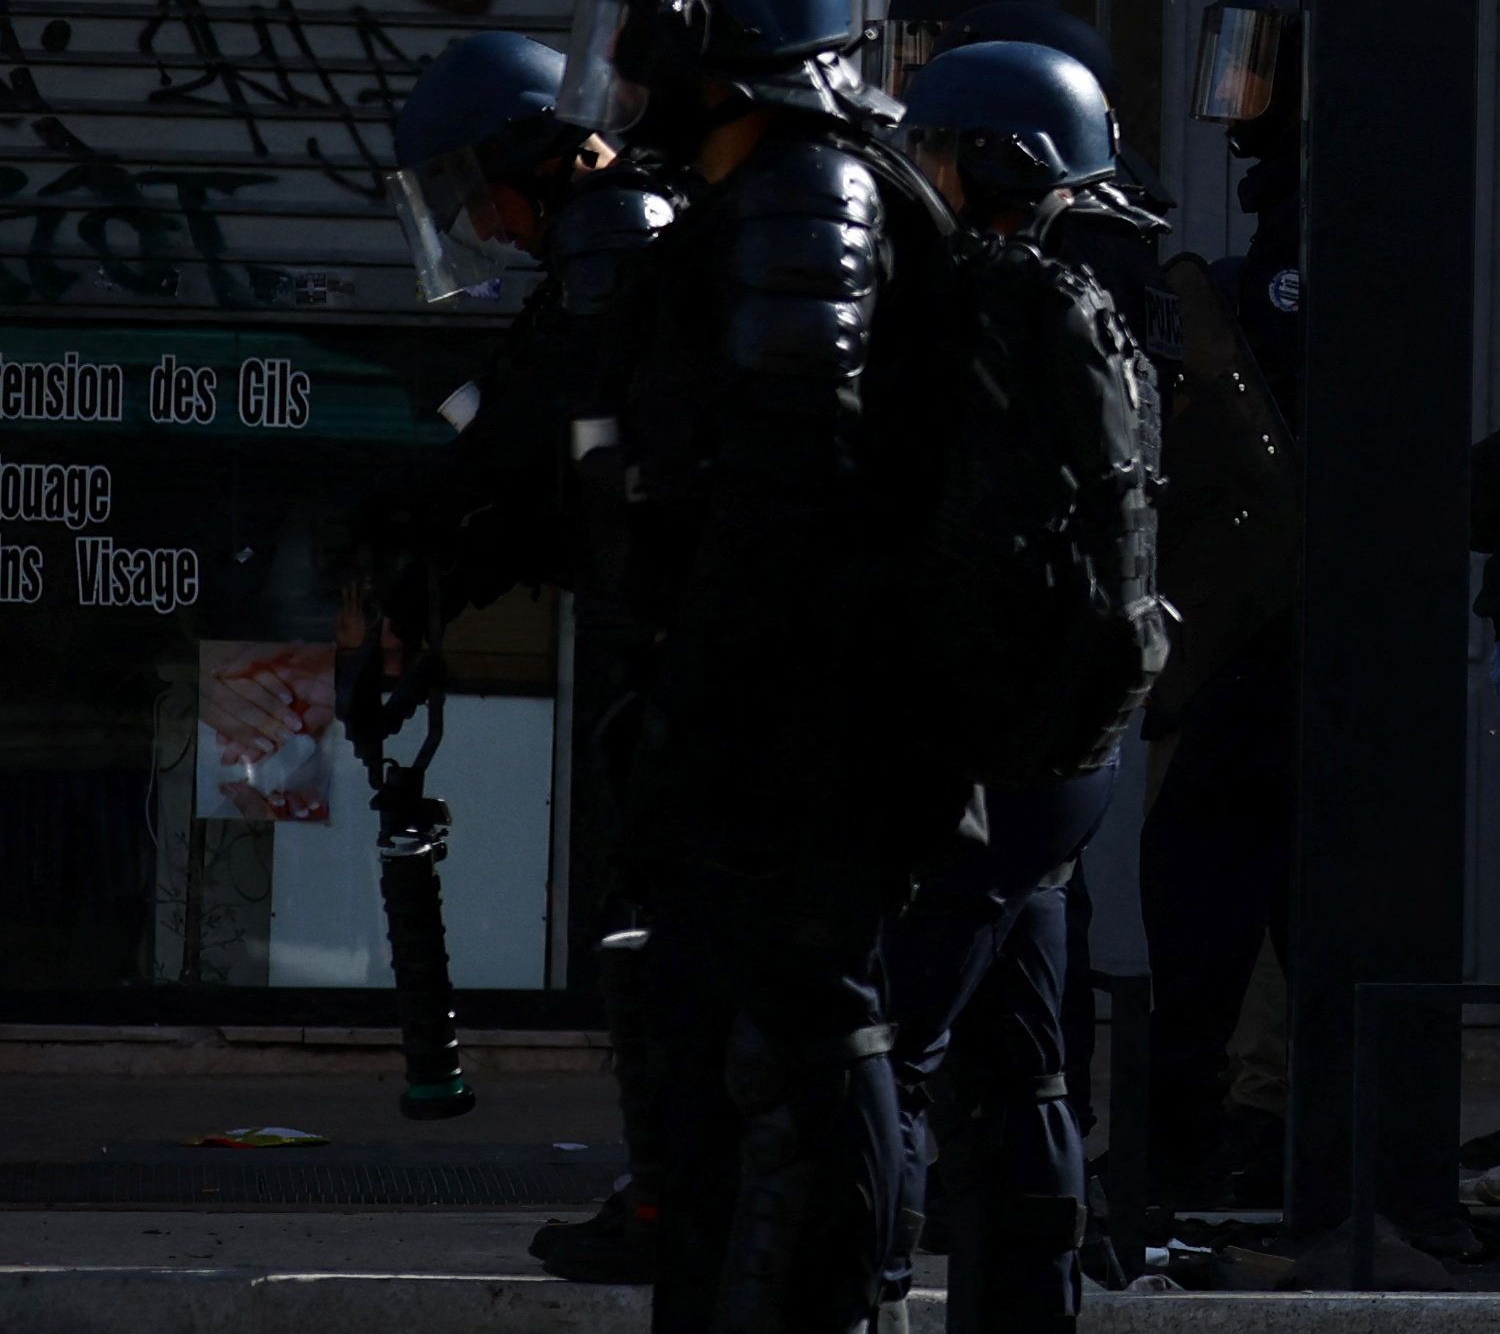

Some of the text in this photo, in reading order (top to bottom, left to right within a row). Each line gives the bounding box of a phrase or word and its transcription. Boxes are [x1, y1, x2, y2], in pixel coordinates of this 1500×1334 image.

[0, 351, 310, 429] ension des Cils
[0, 462, 112, 530] ouage
[0, 536, 199, 614] ns Visage
